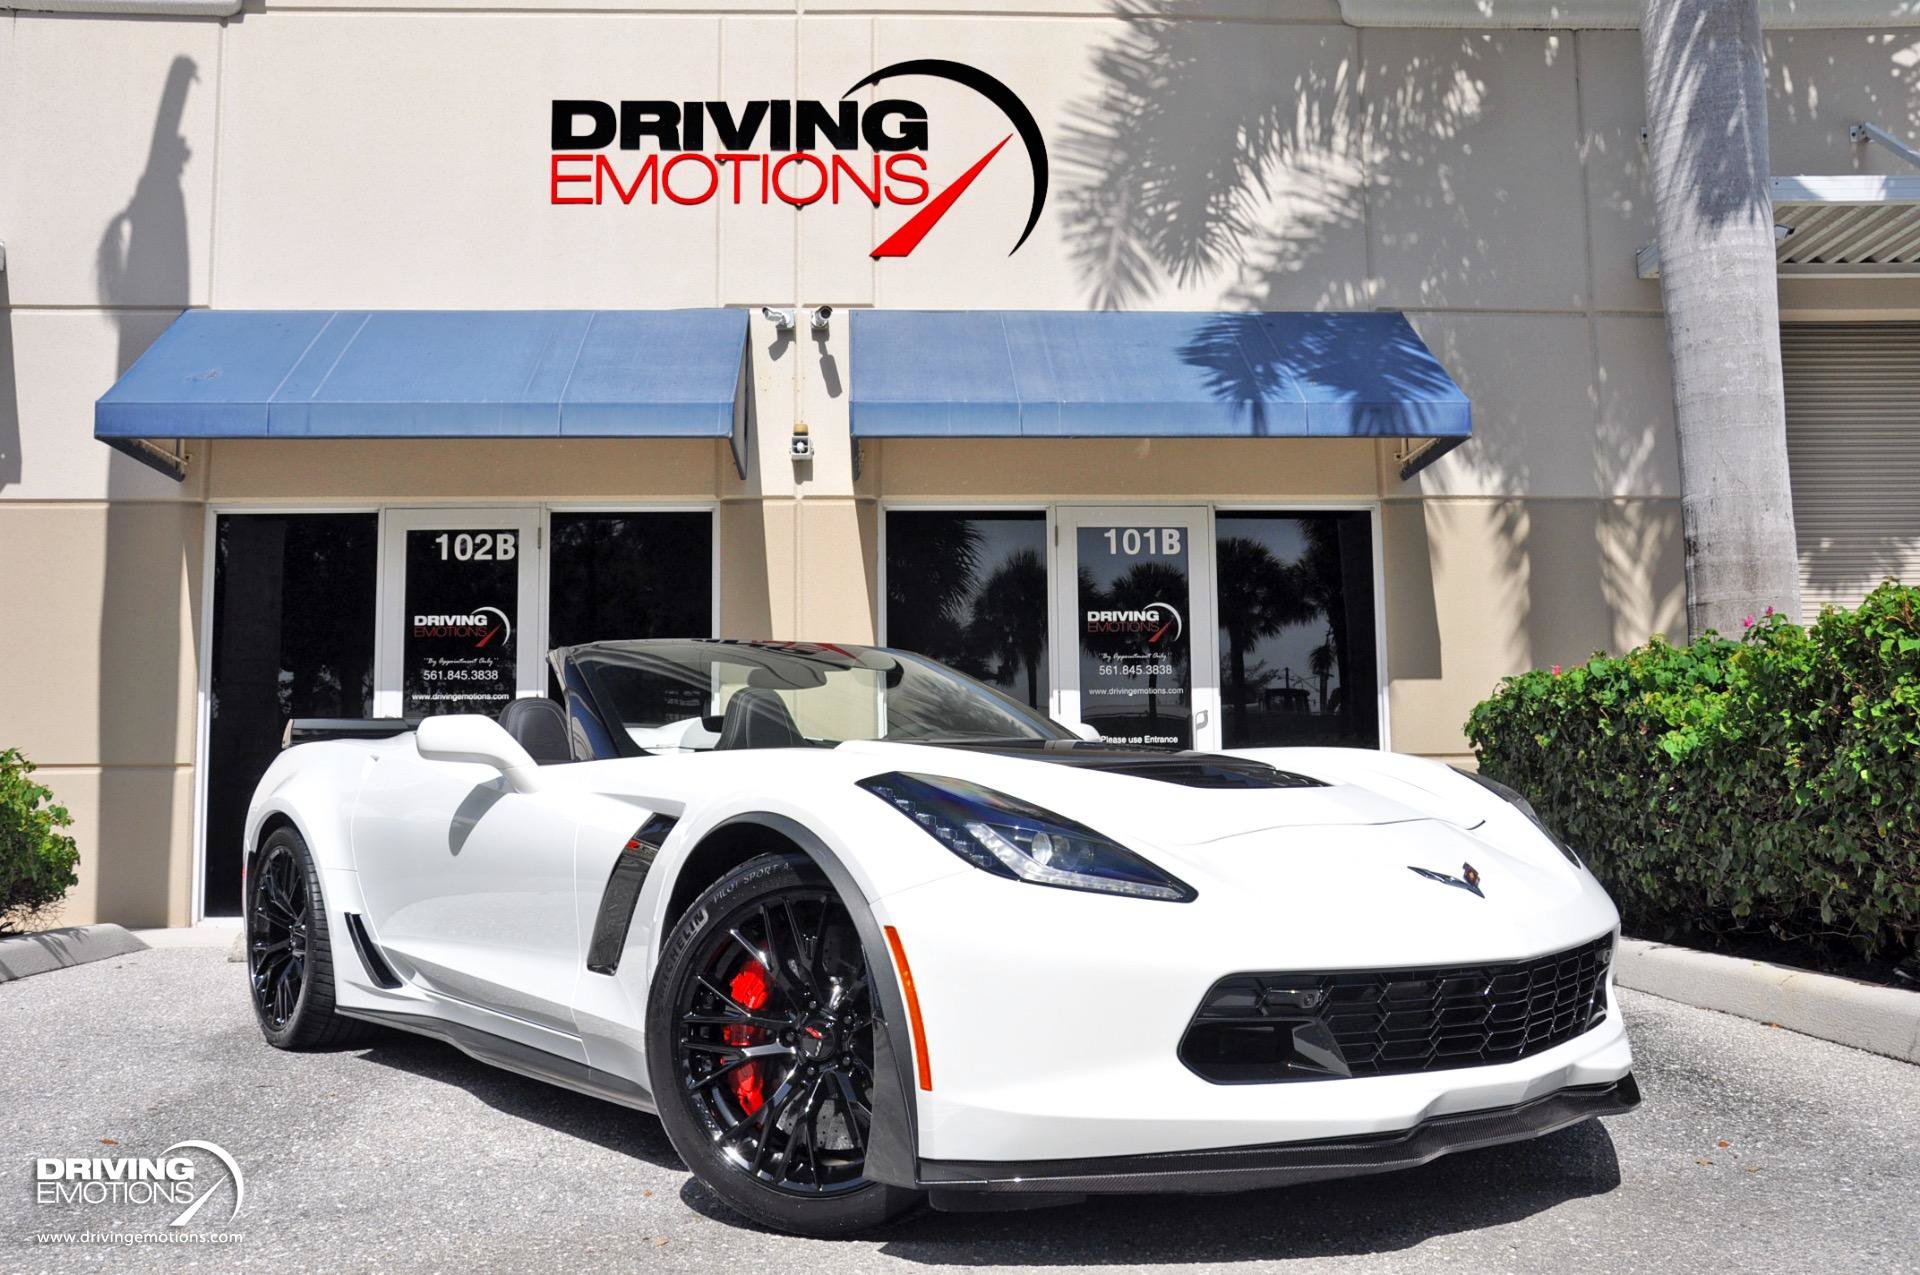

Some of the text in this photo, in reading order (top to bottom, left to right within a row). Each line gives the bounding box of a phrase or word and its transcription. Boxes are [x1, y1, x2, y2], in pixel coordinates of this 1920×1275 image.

[551, 99, 929, 152] DRIVING
[551, 153, 930, 206] EMOTIONS
[435, 533, 516, 562] 102B
[1103, 528, 1181, 556] 101B
[414, 615, 488, 626] DRIVING
[1087, 610, 1160, 622] DRIVING
[414, 626, 488, 638] EMOTIONS
[1087, 621, 1160, 633] EMOTIONS
[438, 657, 479, 666] Appointment
[423, 669, 499, 681] 561.845.3838
[1099, 664, 1173, 676] 561.845.3838
[411, 692, 510, 702] www.drivingemotions.com
[1088, 687, 1184, 697] www.drivingemotions.com
[1101, 735, 1179, 744] Please use Entrance
[743, 863, 779, 885] SPORT
